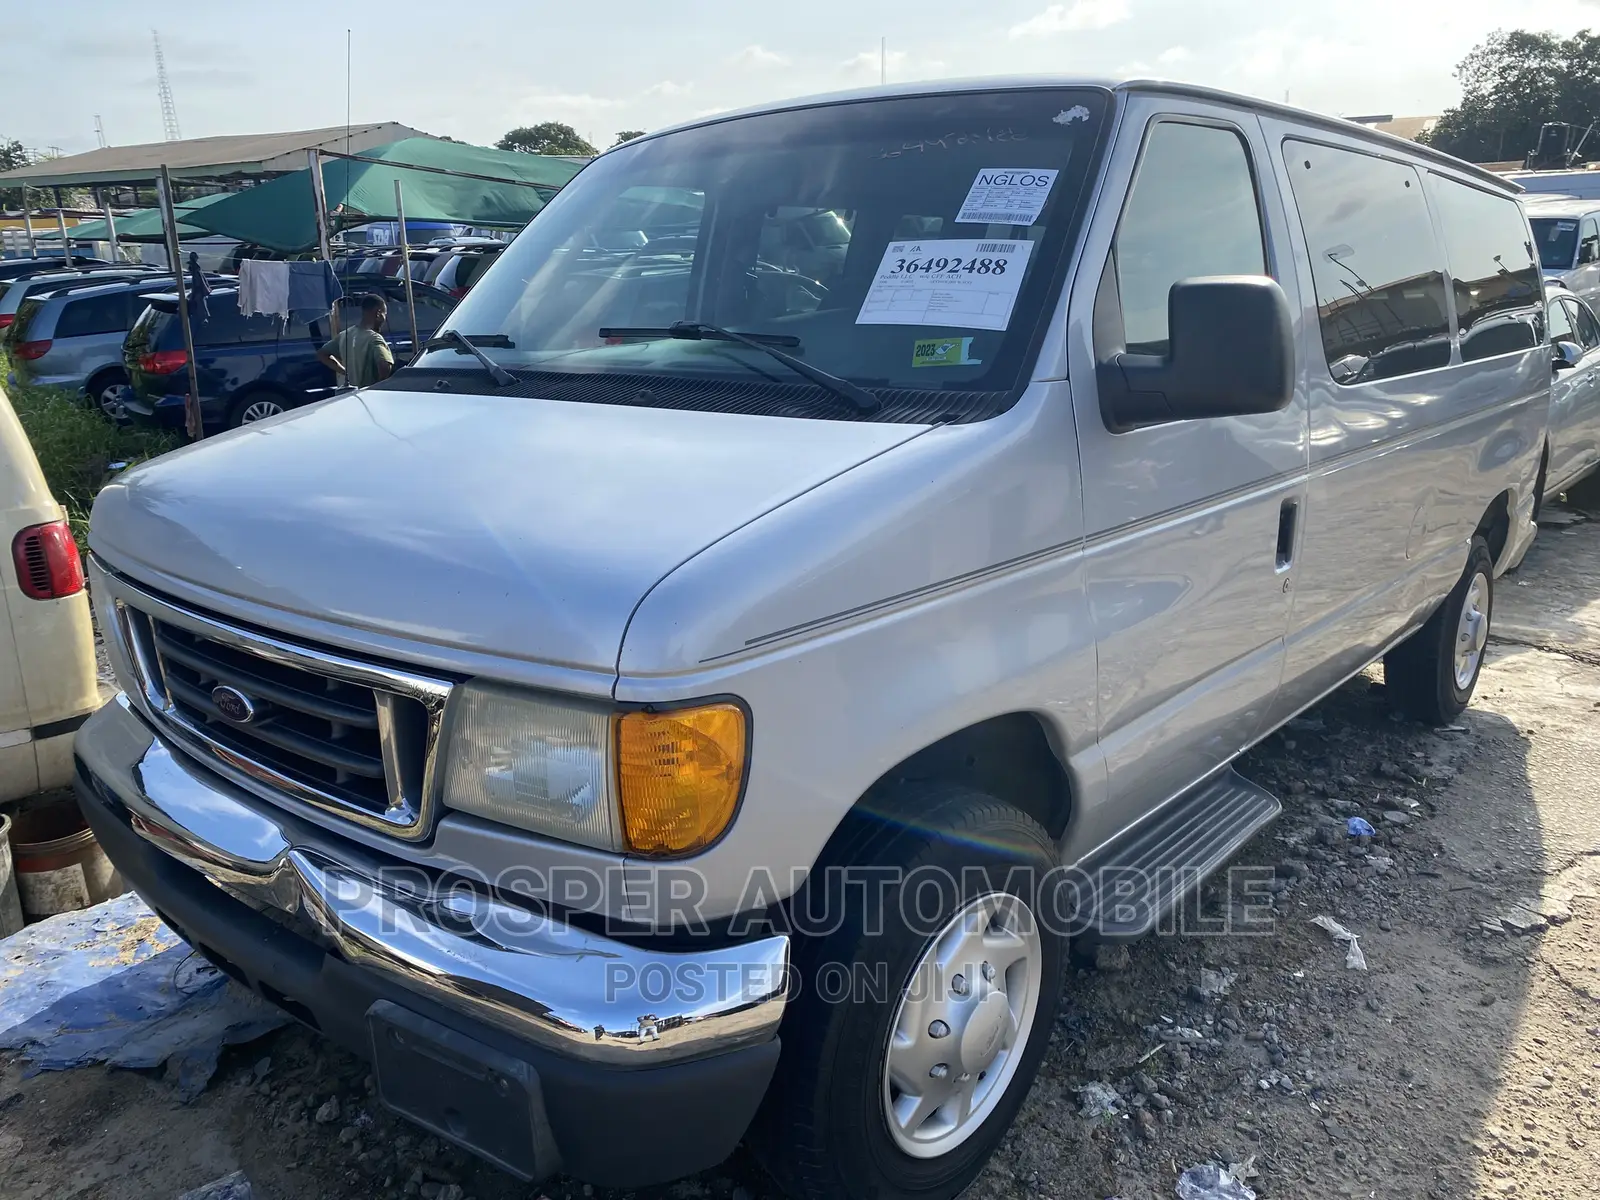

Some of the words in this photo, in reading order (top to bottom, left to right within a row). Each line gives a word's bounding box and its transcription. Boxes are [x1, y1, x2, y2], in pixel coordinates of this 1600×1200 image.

[978, 174, 1050, 187] NGLOS
[890, 257, 1008, 276] 36492488
[915, 343, 936, 357] 2023
